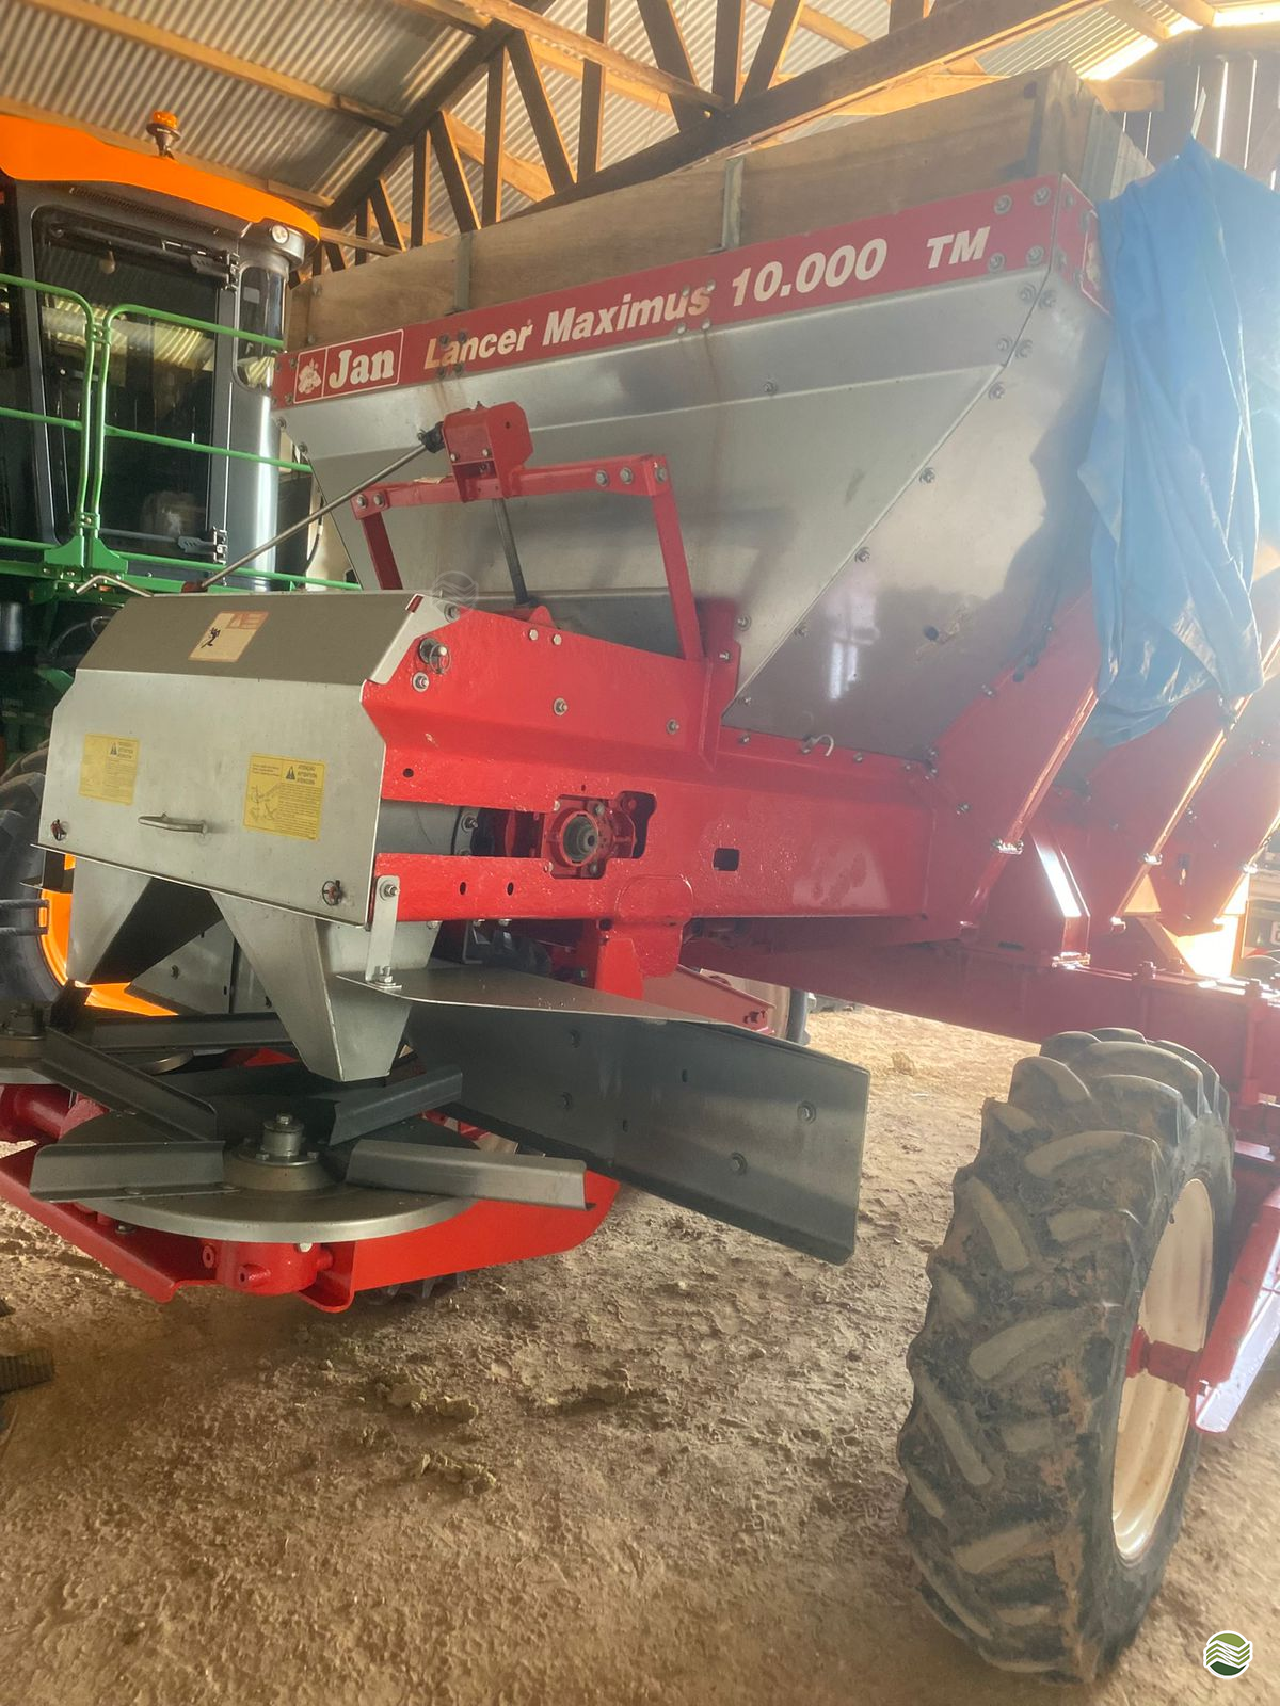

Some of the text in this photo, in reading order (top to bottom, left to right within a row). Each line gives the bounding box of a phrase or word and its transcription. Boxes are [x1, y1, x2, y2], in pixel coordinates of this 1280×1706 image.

[424, 226, 991, 369] Lancer Maximus 10.000 TM
[329, 349, 394, 389] Jan
